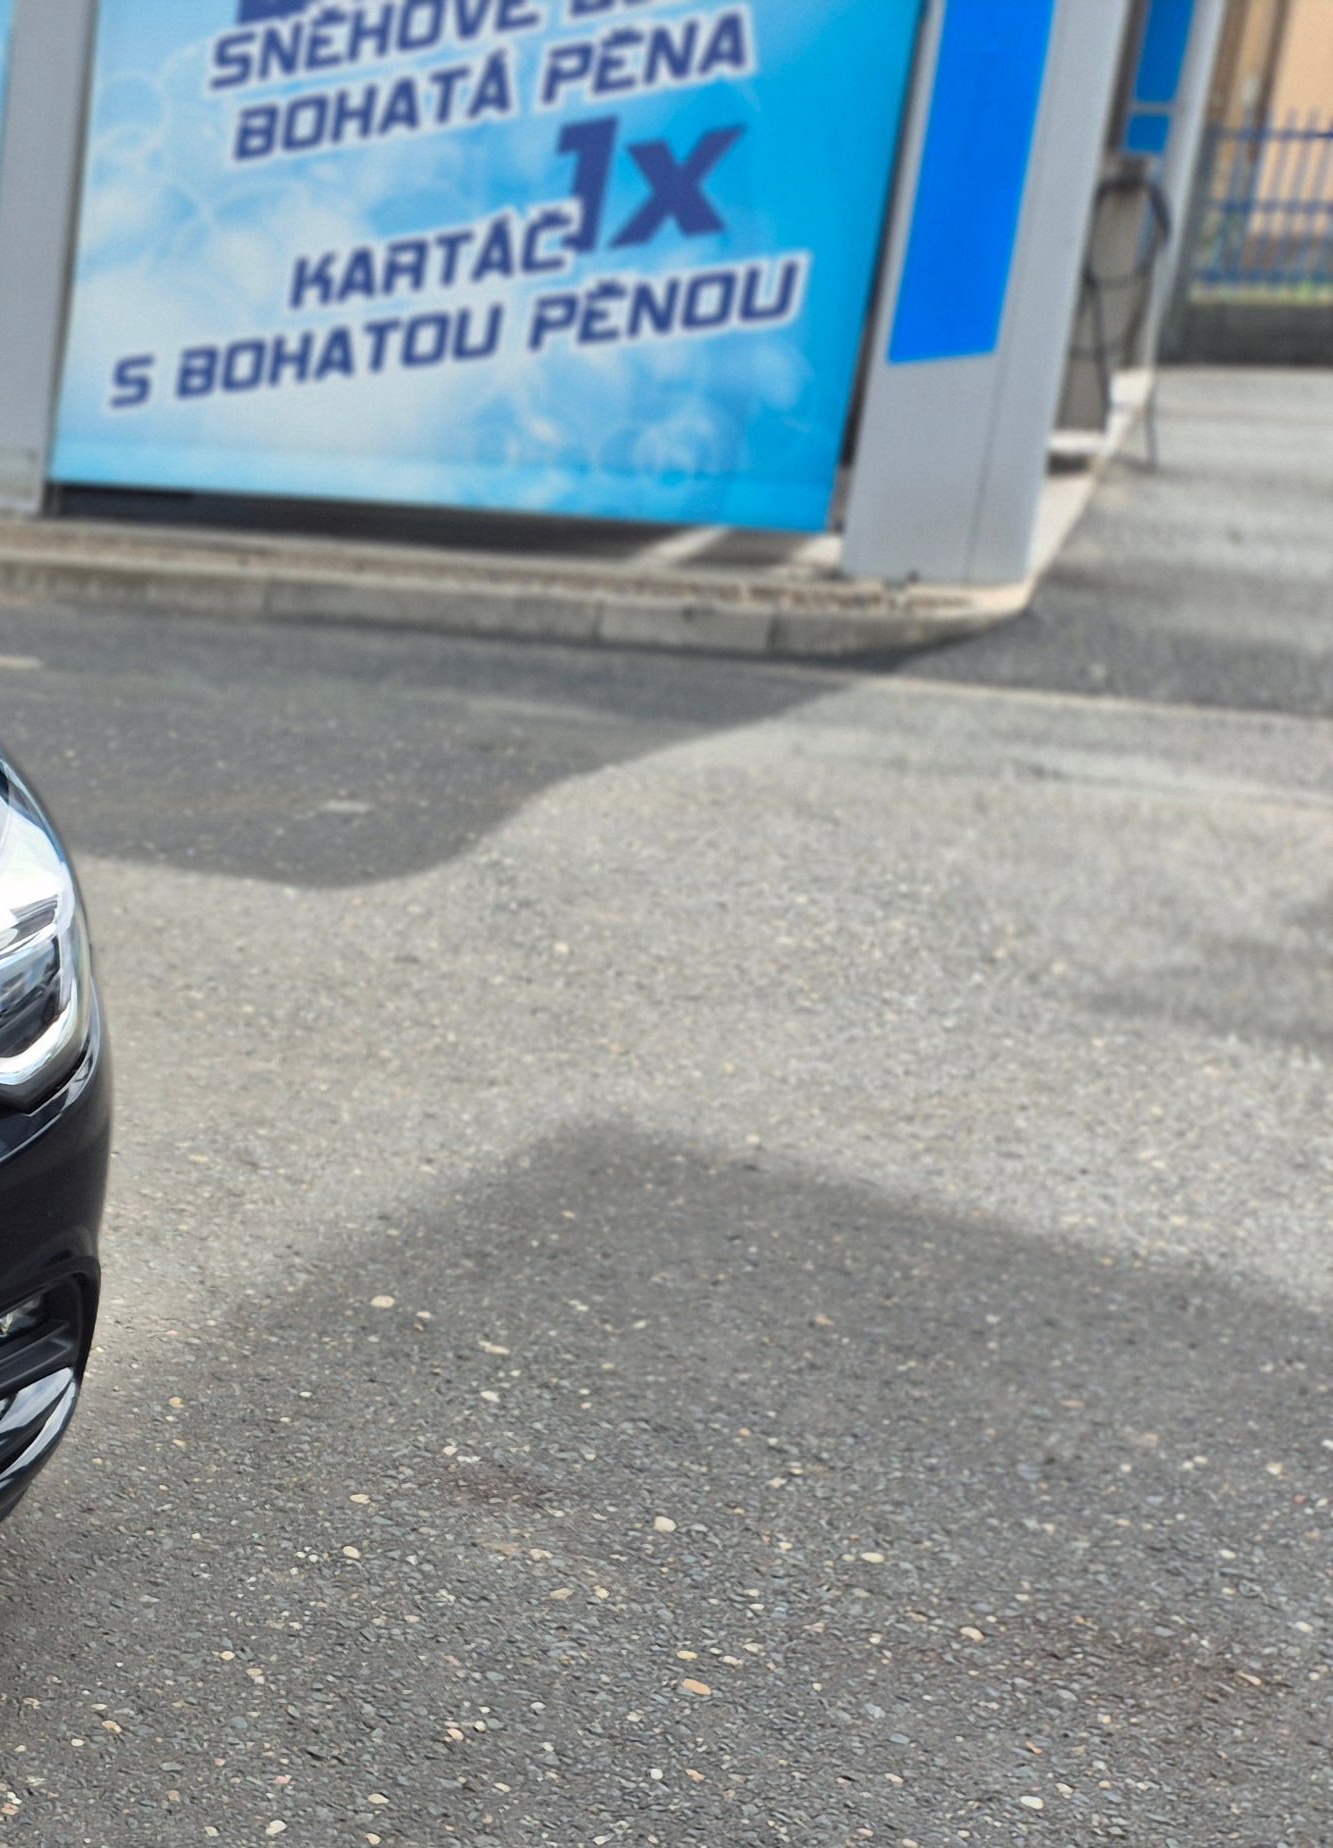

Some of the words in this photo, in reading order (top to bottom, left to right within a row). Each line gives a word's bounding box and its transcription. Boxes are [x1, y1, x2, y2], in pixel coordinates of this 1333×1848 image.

[233, 48, 511, 160] BOHATÁ
[541, 13, 746, 104] PĚNA
[290, 209, 573, 308] KARTÁČ
[110, 356, 154, 407] S
[176, 304, 502, 399] BOHATOU
[528, 260, 800, 351] PĚNOU
